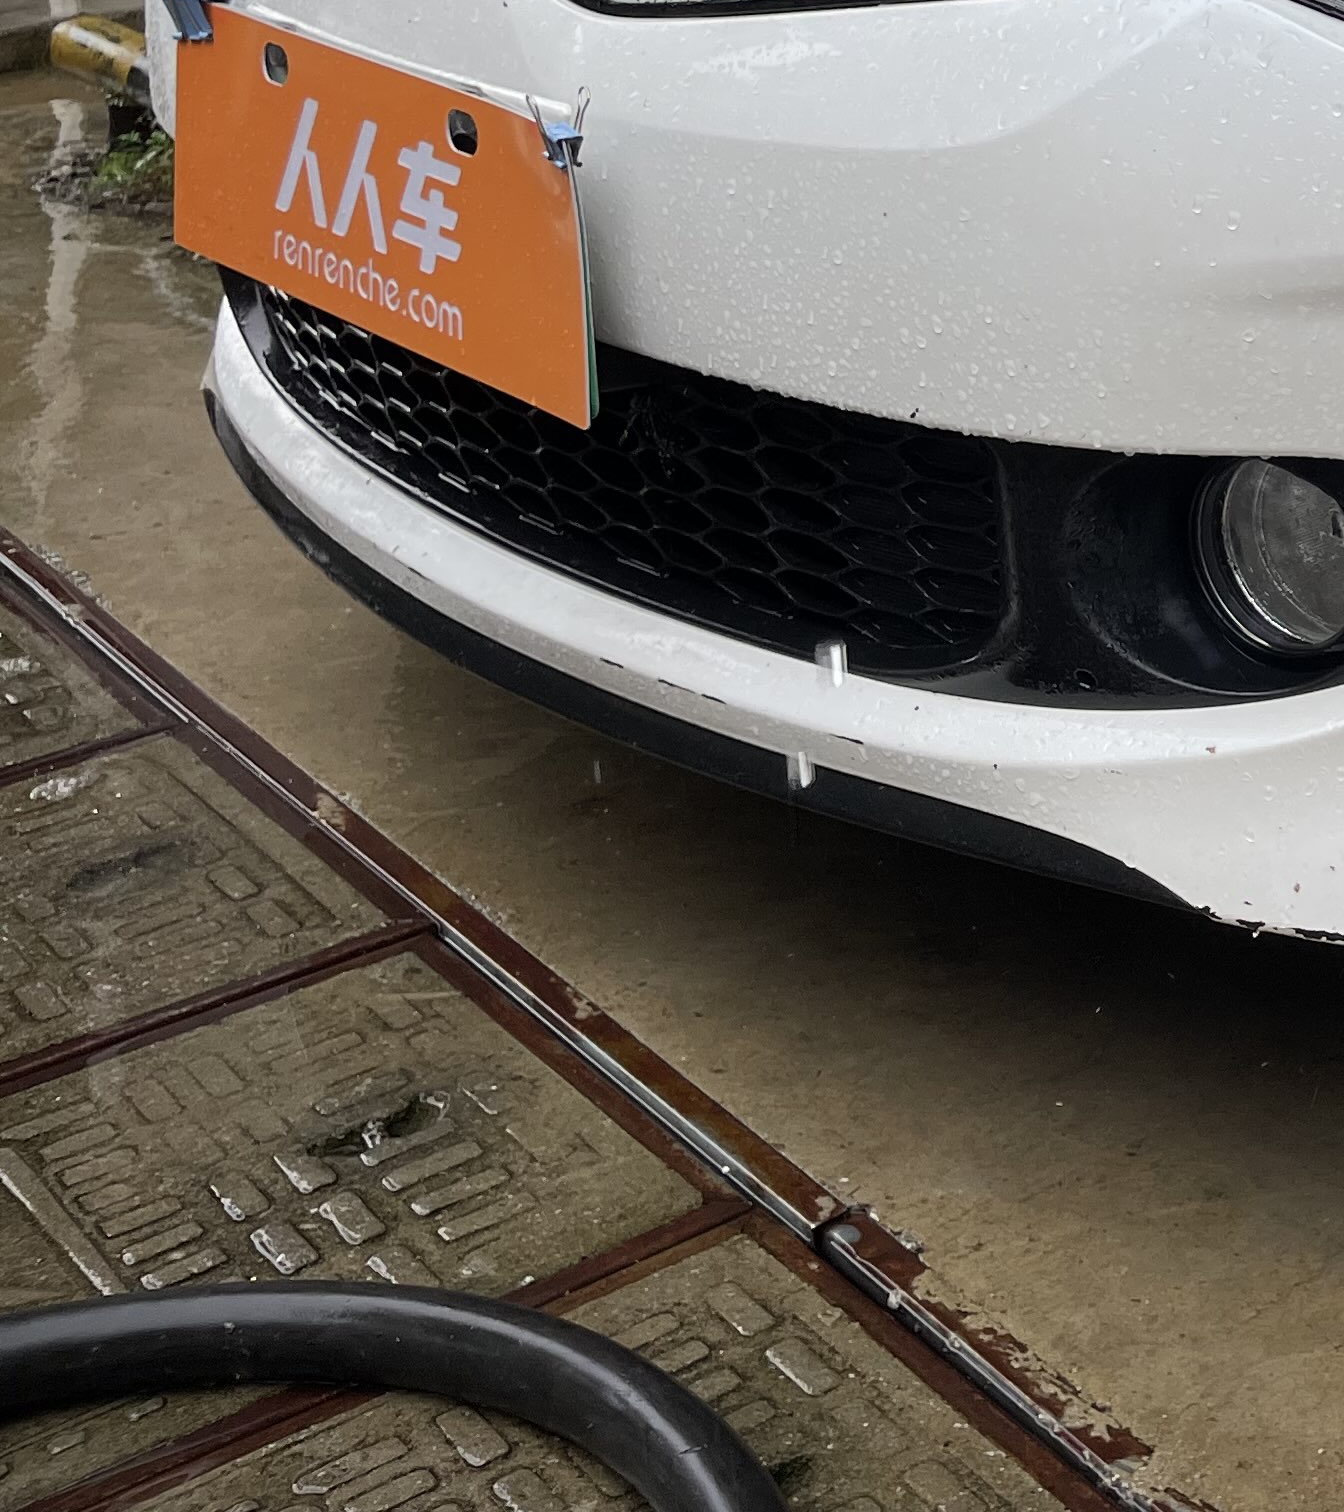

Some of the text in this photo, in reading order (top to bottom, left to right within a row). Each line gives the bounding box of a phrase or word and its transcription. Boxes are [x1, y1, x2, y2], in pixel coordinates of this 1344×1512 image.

[275, 97, 462, 275] 人人车
[273, 229, 464, 341] renrenche.com
